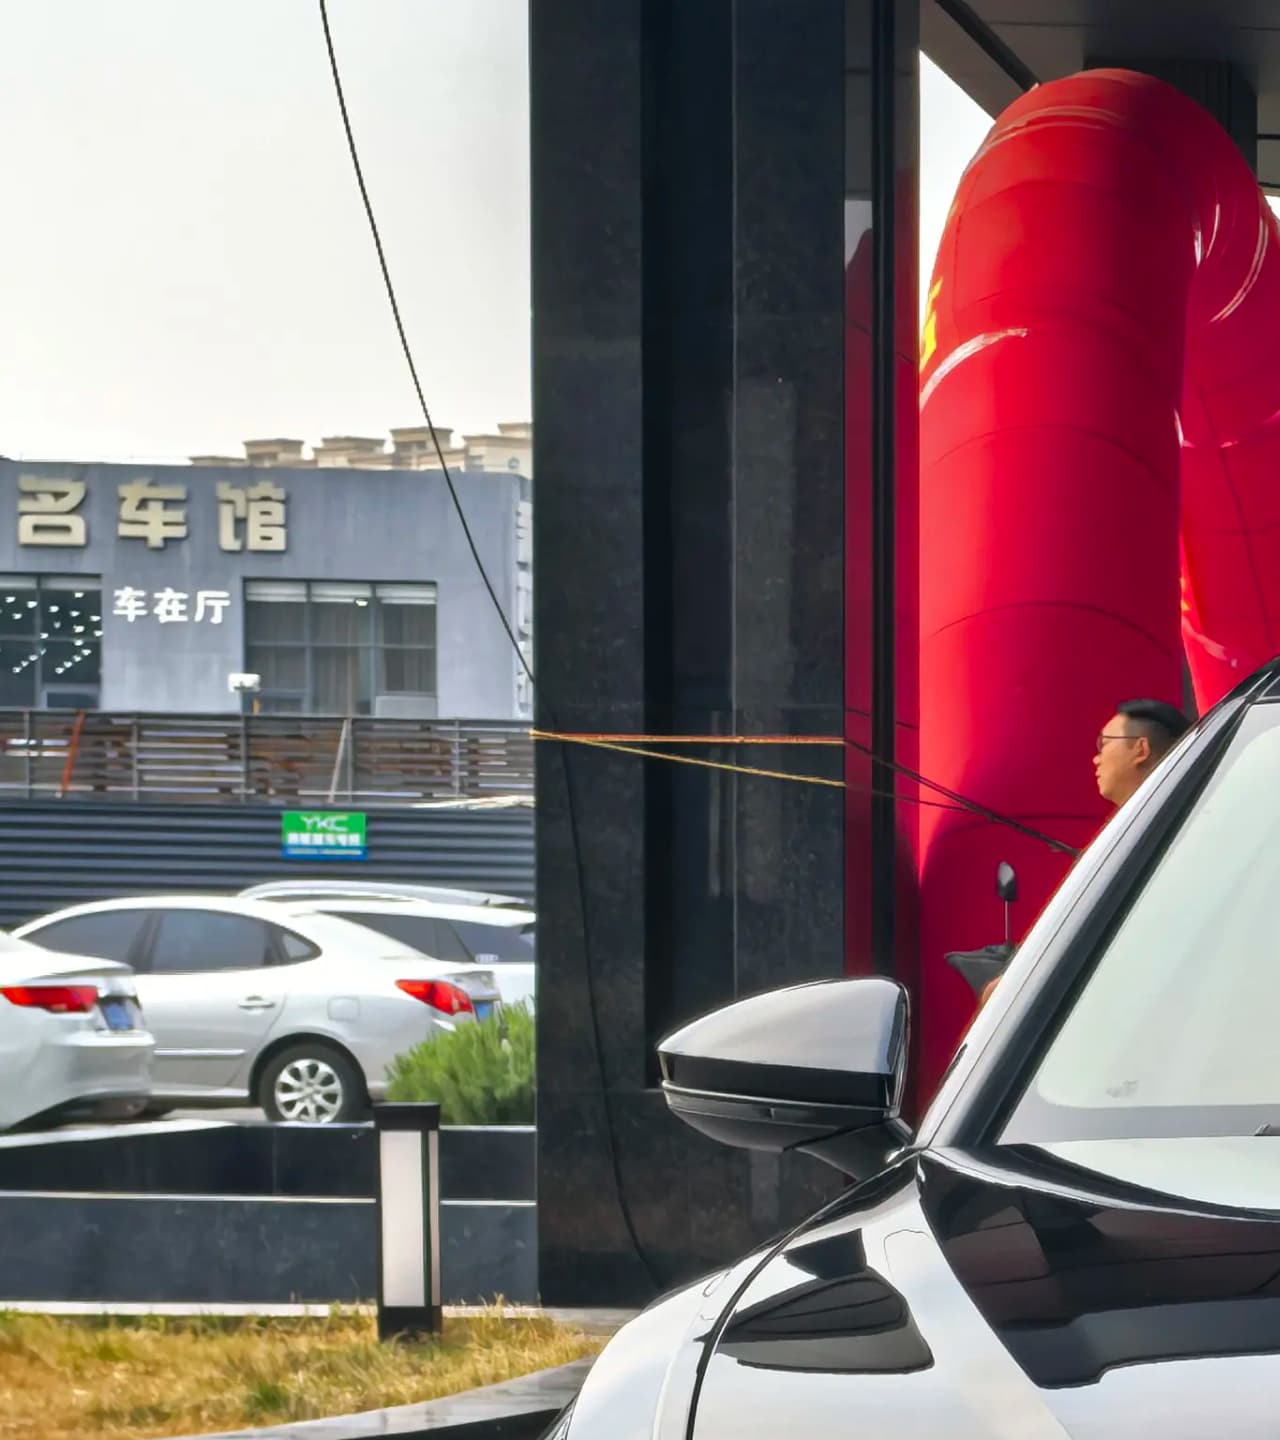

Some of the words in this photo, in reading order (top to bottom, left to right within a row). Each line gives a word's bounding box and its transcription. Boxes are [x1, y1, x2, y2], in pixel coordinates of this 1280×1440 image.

[18, 474, 287, 551] 名车馆
[113, 586, 231, 624] 车在厅
